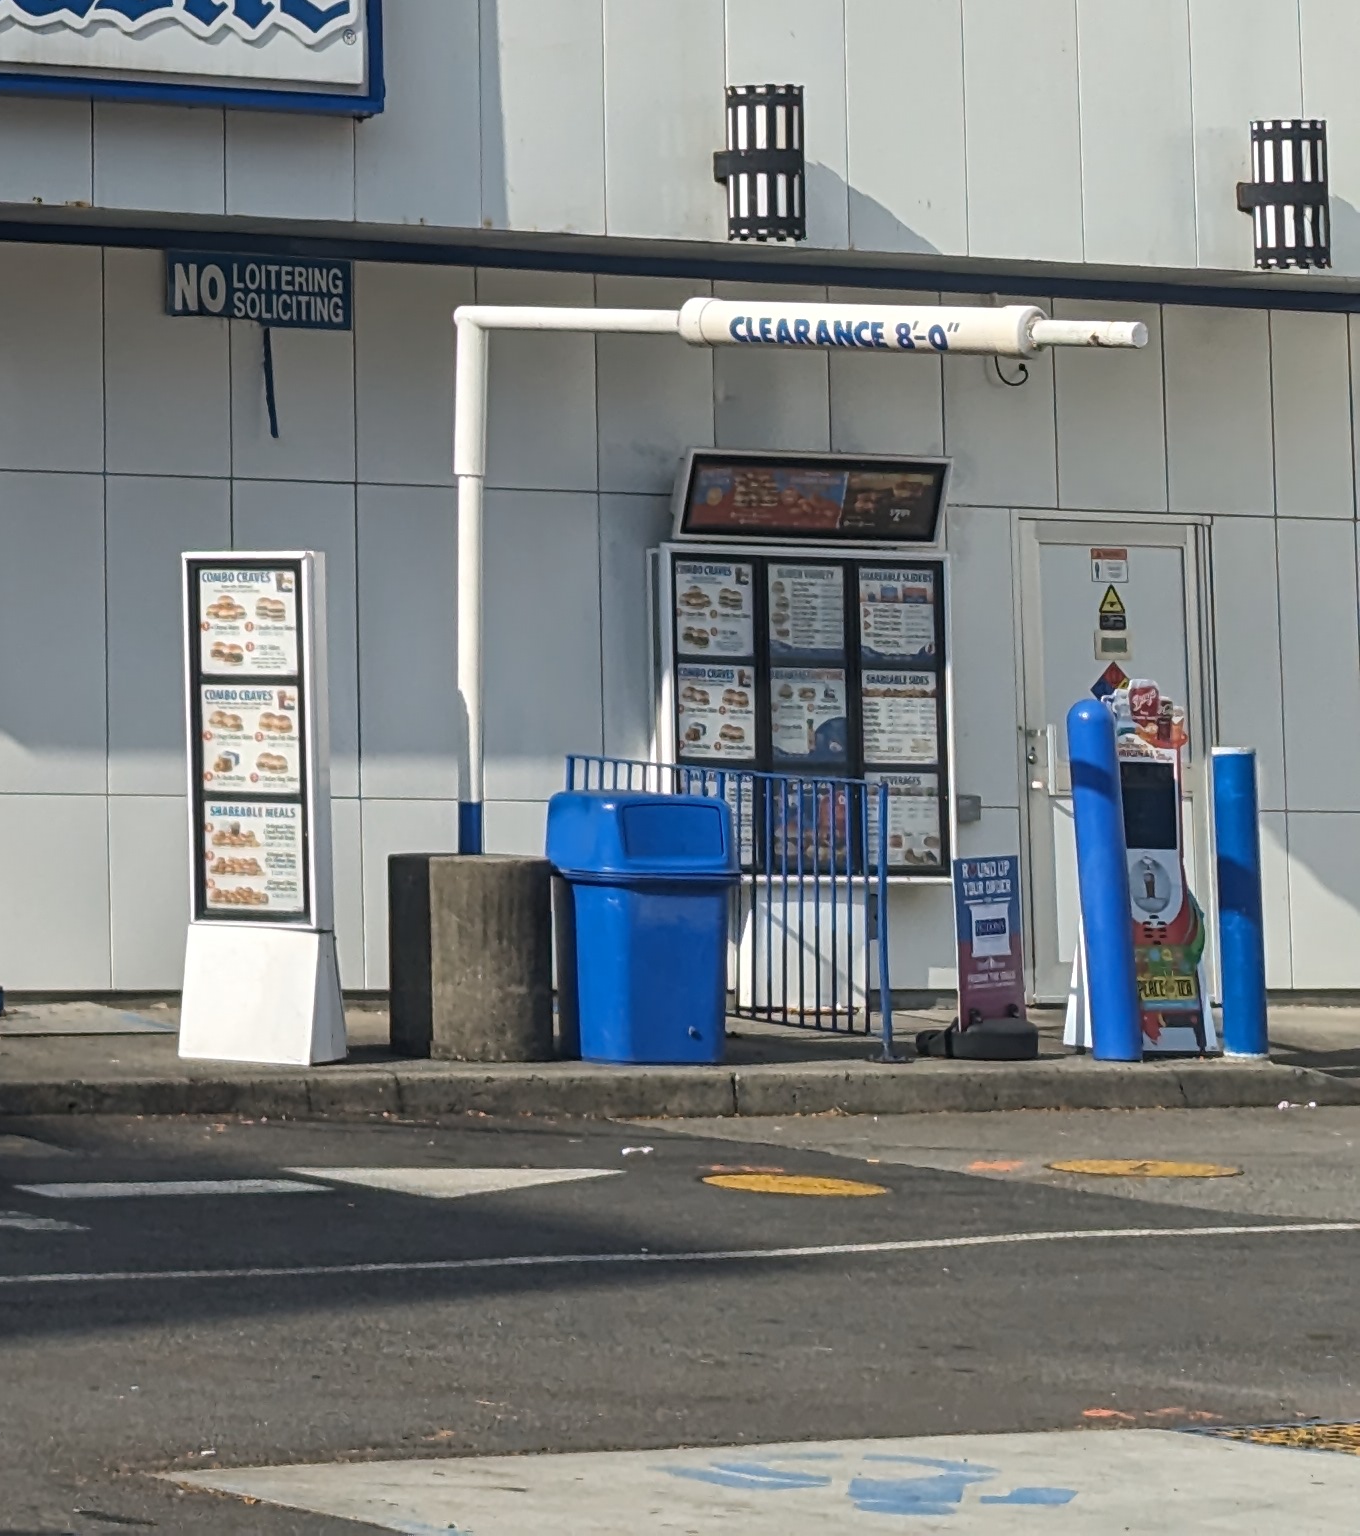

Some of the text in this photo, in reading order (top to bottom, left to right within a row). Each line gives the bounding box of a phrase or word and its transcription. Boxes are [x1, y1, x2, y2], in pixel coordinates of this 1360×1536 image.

[174, 263, 226, 312] NO
[233, 263, 343, 294] LOITERING
[233, 292, 344, 323] SOLICITING
[730, 316, 888, 347] CLEARANCE
[202, 572, 271, 583] COMBO CRAVES
[204, 690, 274, 701] COMBO CRAVES
[210, 806, 296, 818] SHAREABLE MEALS
